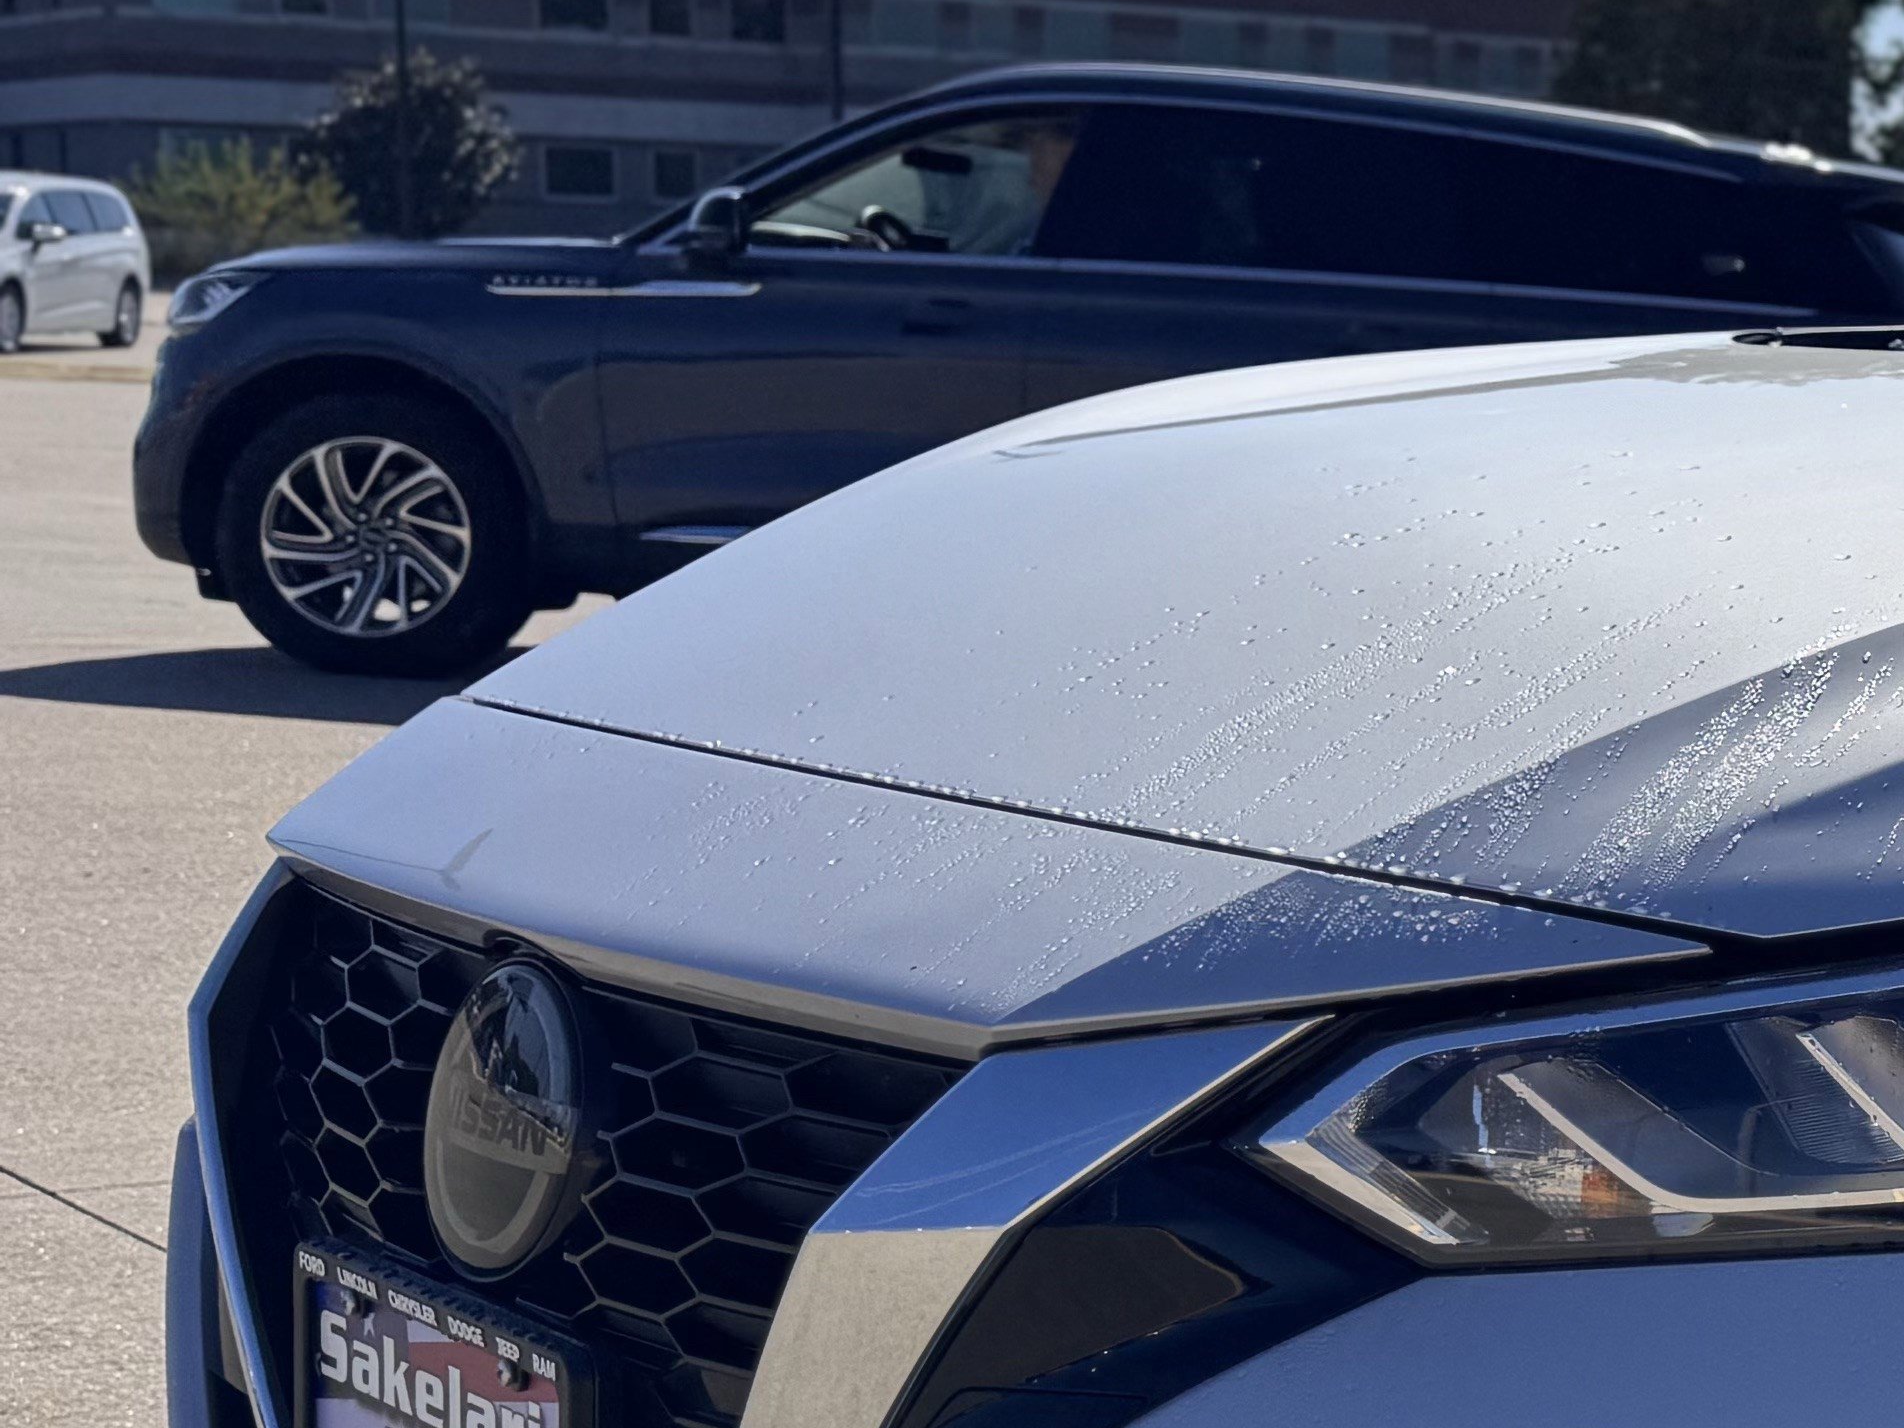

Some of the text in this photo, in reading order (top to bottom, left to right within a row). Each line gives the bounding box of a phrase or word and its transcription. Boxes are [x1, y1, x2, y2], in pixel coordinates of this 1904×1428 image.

[299, 1250, 326, 1277] FORD
[336, 1266, 378, 1301] LINCOLN
[387, 1288, 438, 1327] CHRYSLER
[447, 1315, 485, 1348] DODGE
[532, 1352, 556, 1382] RAM
